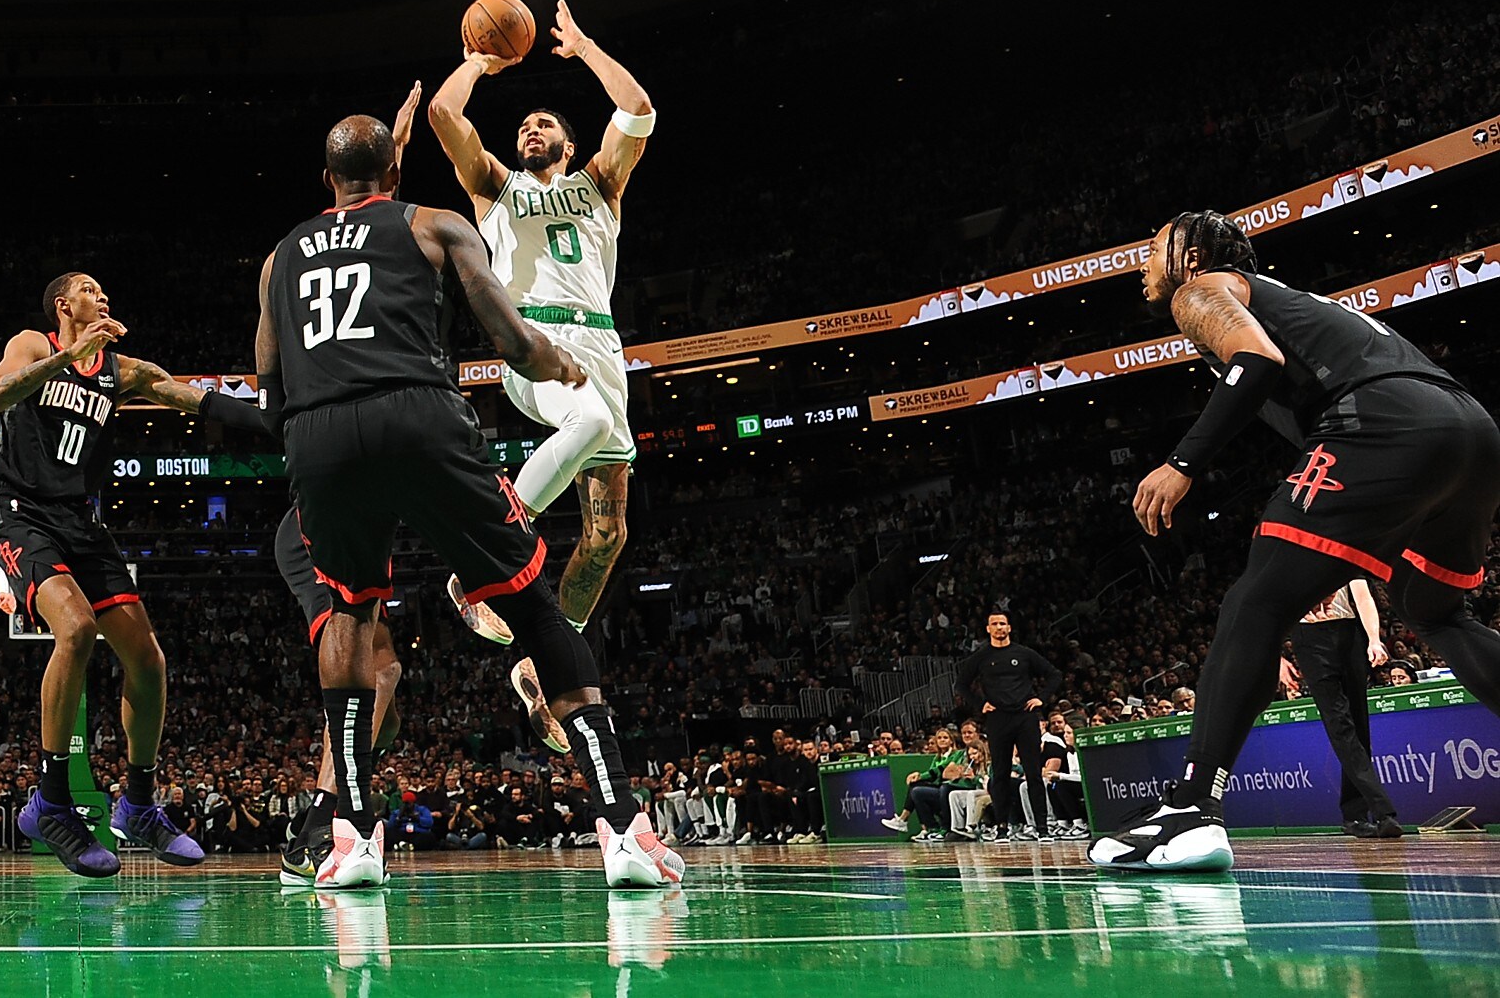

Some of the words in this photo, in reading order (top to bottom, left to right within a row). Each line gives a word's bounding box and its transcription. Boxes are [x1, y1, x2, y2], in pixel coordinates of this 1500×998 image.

[513, 187, 595, 220] CELTICS
[299, 224, 371, 259] GREEN
[545, 222, 583, 265] 0
[1033, 247, 1150, 289] UNEXPECTE
[299, 262, 375, 350] 32
[820, 309, 892, 330] SKREWBALL
[39, 381, 113, 427] HOUSTON
[899, 386, 969, 406] SKREWBALL
[739, 419, 759, 433] TD
[764, 415, 794, 429] Bank
[804, 409, 835, 424] 7:35
[837, 405, 859, 421] PM
[57, 420, 87, 466] 10
[499, 451, 507, 462] 5
[113, 459, 141, 477] 30
[156, 458, 210, 476] BOSTON
[1102, 777, 1127, 800] The
[1130, 776, 1160, 798] next
[1244, 762, 1313, 791] network
[840, 790, 870, 820] xfinity
